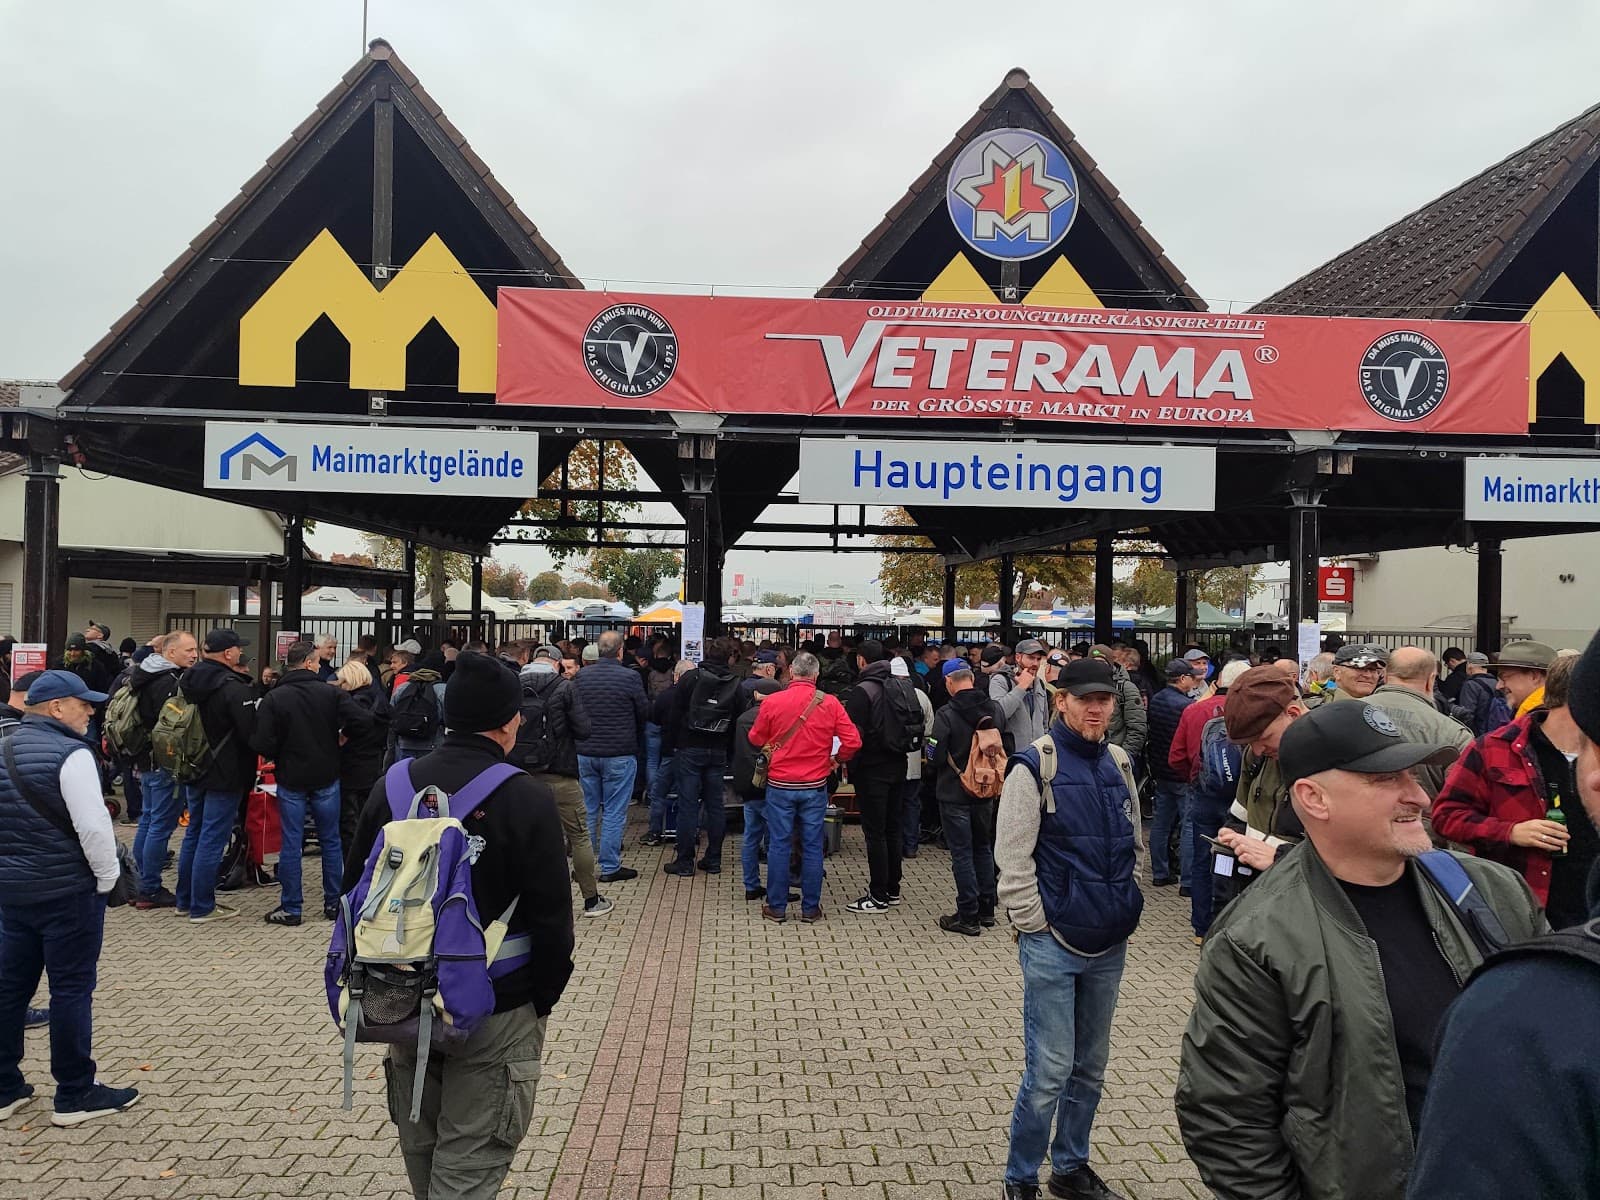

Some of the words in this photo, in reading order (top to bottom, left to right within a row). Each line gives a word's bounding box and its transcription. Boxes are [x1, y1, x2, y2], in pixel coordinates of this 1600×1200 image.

[592, 320, 605, 334] DA
[602, 307, 625, 323] MUSS
[627, 307, 648, 319] MAN
[867, 305, 1266, 331] OLDTIMER-YOUNGTIMER-KLASSIKER-TEILE
[766, 319, 1254, 410] VETERAMA
[1367, 347, 1380, 360] DA
[1377, 334, 1400, 351] MUSS
[1401, 333, 1421, 345] MAN
[587, 345, 598, 366] DAS
[595, 368, 643, 393] ORIGINAL
[645, 370, 666, 389] SEIT
[663, 344, 674, 369] 1975
[871, 400, 909, 411] DER
[918, 395, 1033, 414] GRÖSSTE
[1038, 401, 1126, 418] MARKT
[1156, 406, 1255, 423] EUROPA
[1362, 371, 1373, 392] DAS
[1369, 394, 1415, 417] ORIGINAL
[1417, 395, 1437, 414] SEIT
[1434, 369, 1445, 393] 1975
[312, 444, 524, 483] Maimarktgelände
[854, 449, 1162, 503] Haupteingang
